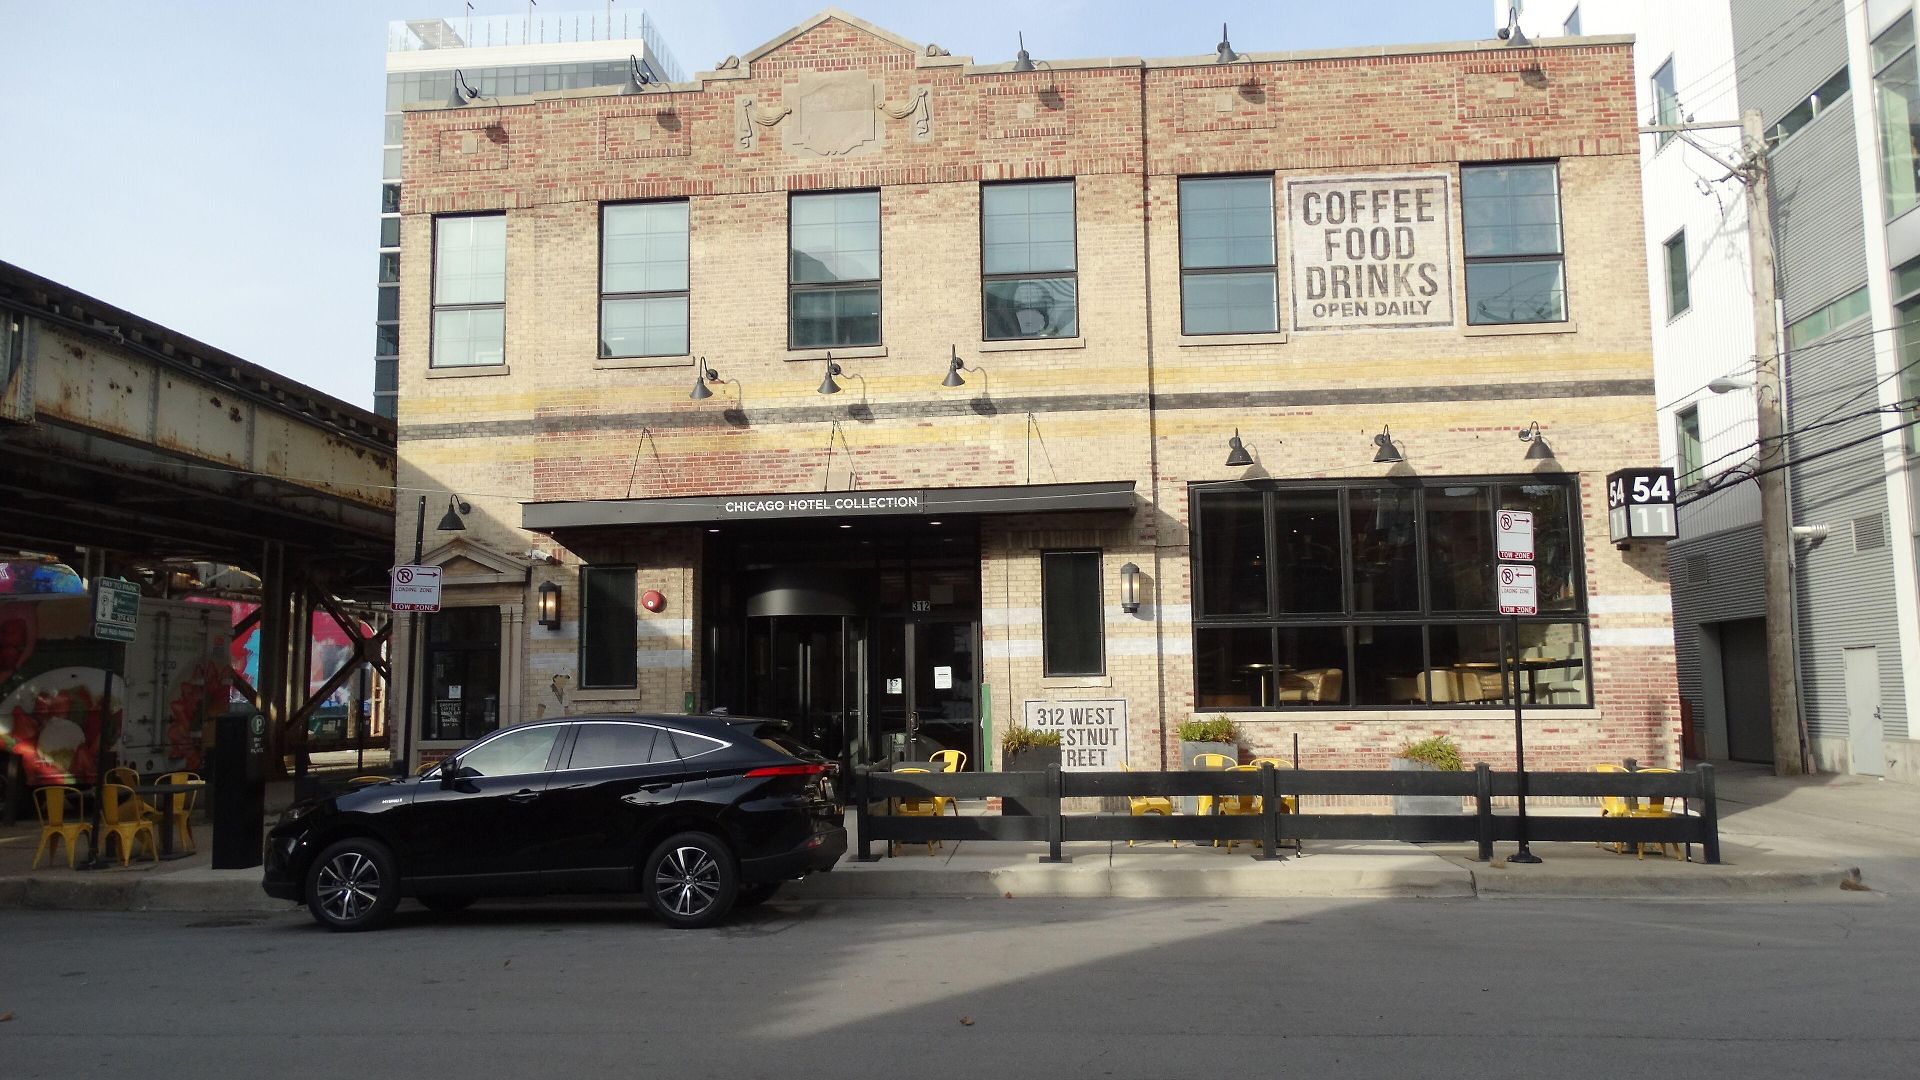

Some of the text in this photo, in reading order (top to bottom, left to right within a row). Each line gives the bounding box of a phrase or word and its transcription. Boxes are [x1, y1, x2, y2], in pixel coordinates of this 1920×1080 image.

[1303, 188, 1435, 225] COFFEE
[1324, 226, 1415, 261] FOOD
[1306, 263, 1438, 300] DRINKS
[1312, 300, 1432, 318] OPEN DAILY
[1610, 477, 1624, 507] 54
[1632, 475, 1670, 502] 54
[725, 496, 919, 512] CHICAGO HOTEL COLLECTION
[1612, 509, 1626, 537] 11
[1637, 507, 1669, 533] 11
[913, 601, 931, 611] 312
[1037, 708, 1115, 725] 312 WEST
[1034, 728, 1119, 746] ESTNUT
[1060, 748, 1107, 766] TREET
